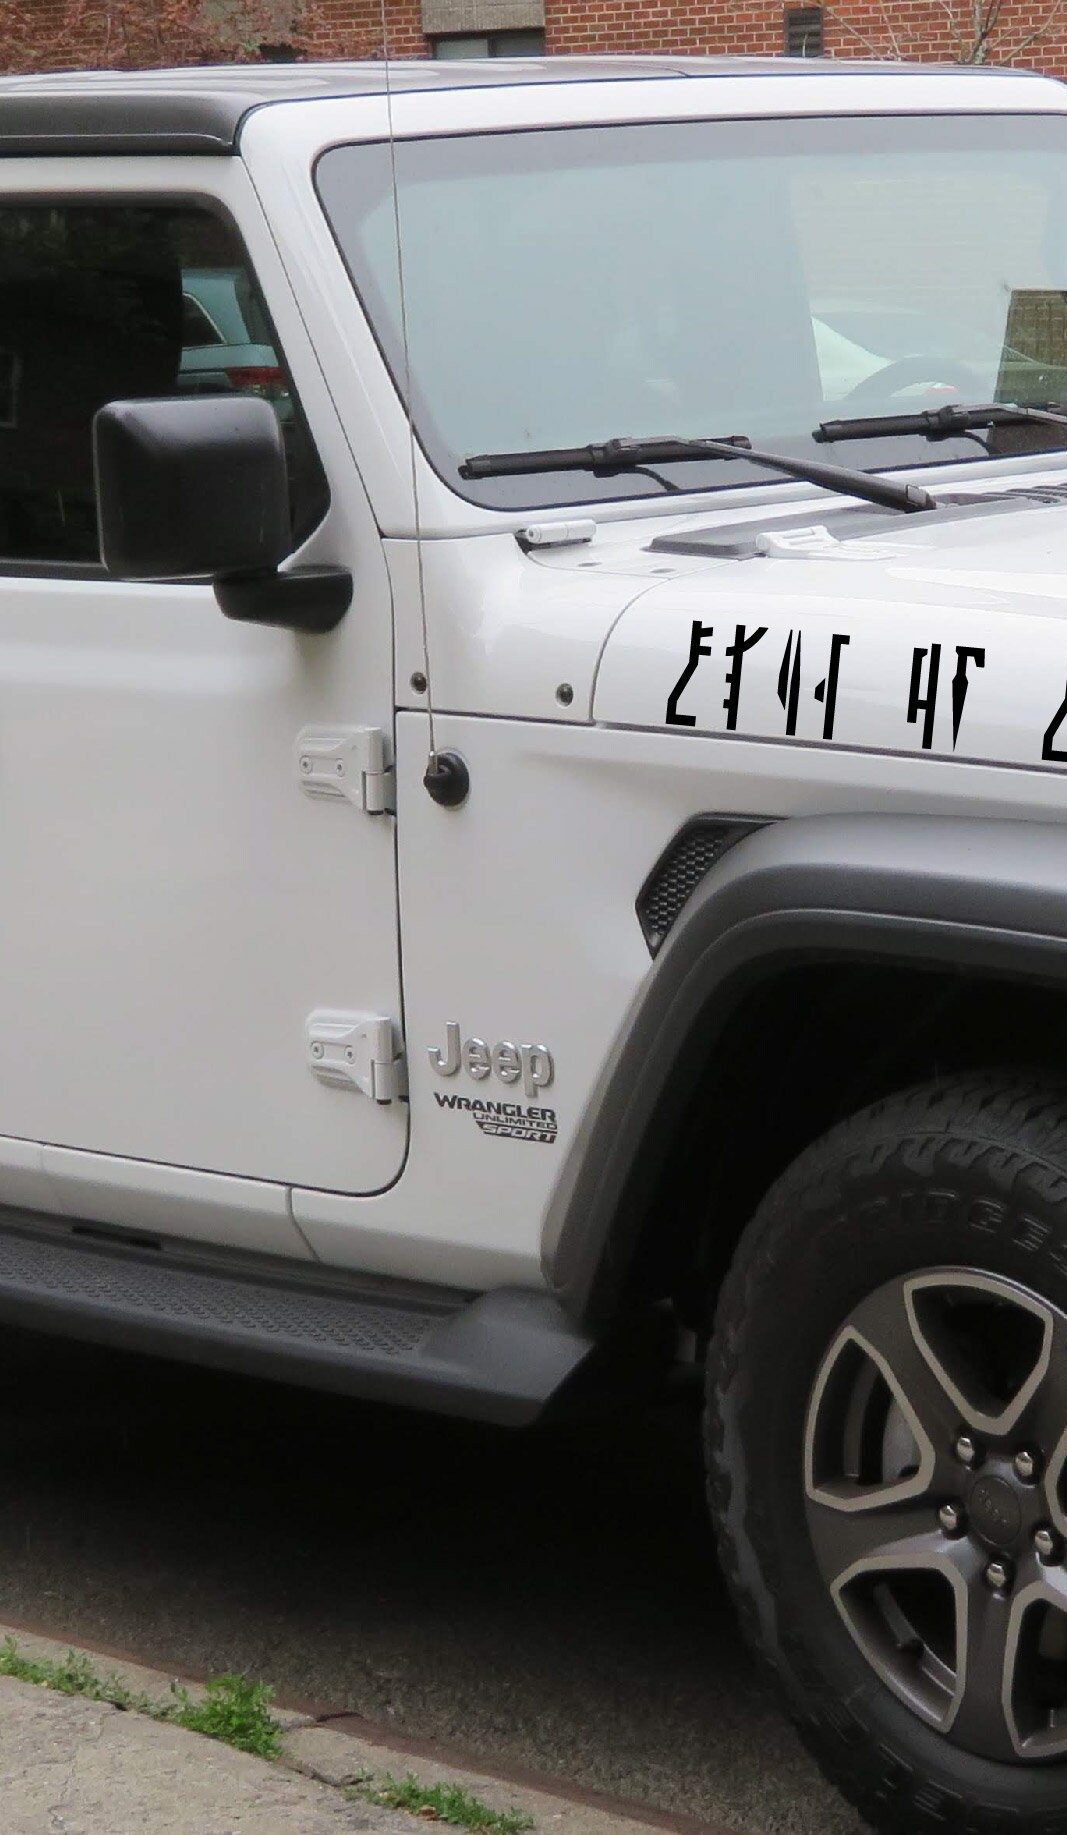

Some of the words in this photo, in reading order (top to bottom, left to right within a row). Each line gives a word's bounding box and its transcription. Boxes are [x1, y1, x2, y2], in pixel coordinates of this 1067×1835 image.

[427, 1020, 554, 1099] Jeep
[433, 1091, 557, 1122] WRANGLER
[472, 1111, 558, 1130] UNLIMITED
[481, 1123, 556, 1143] SPORT
